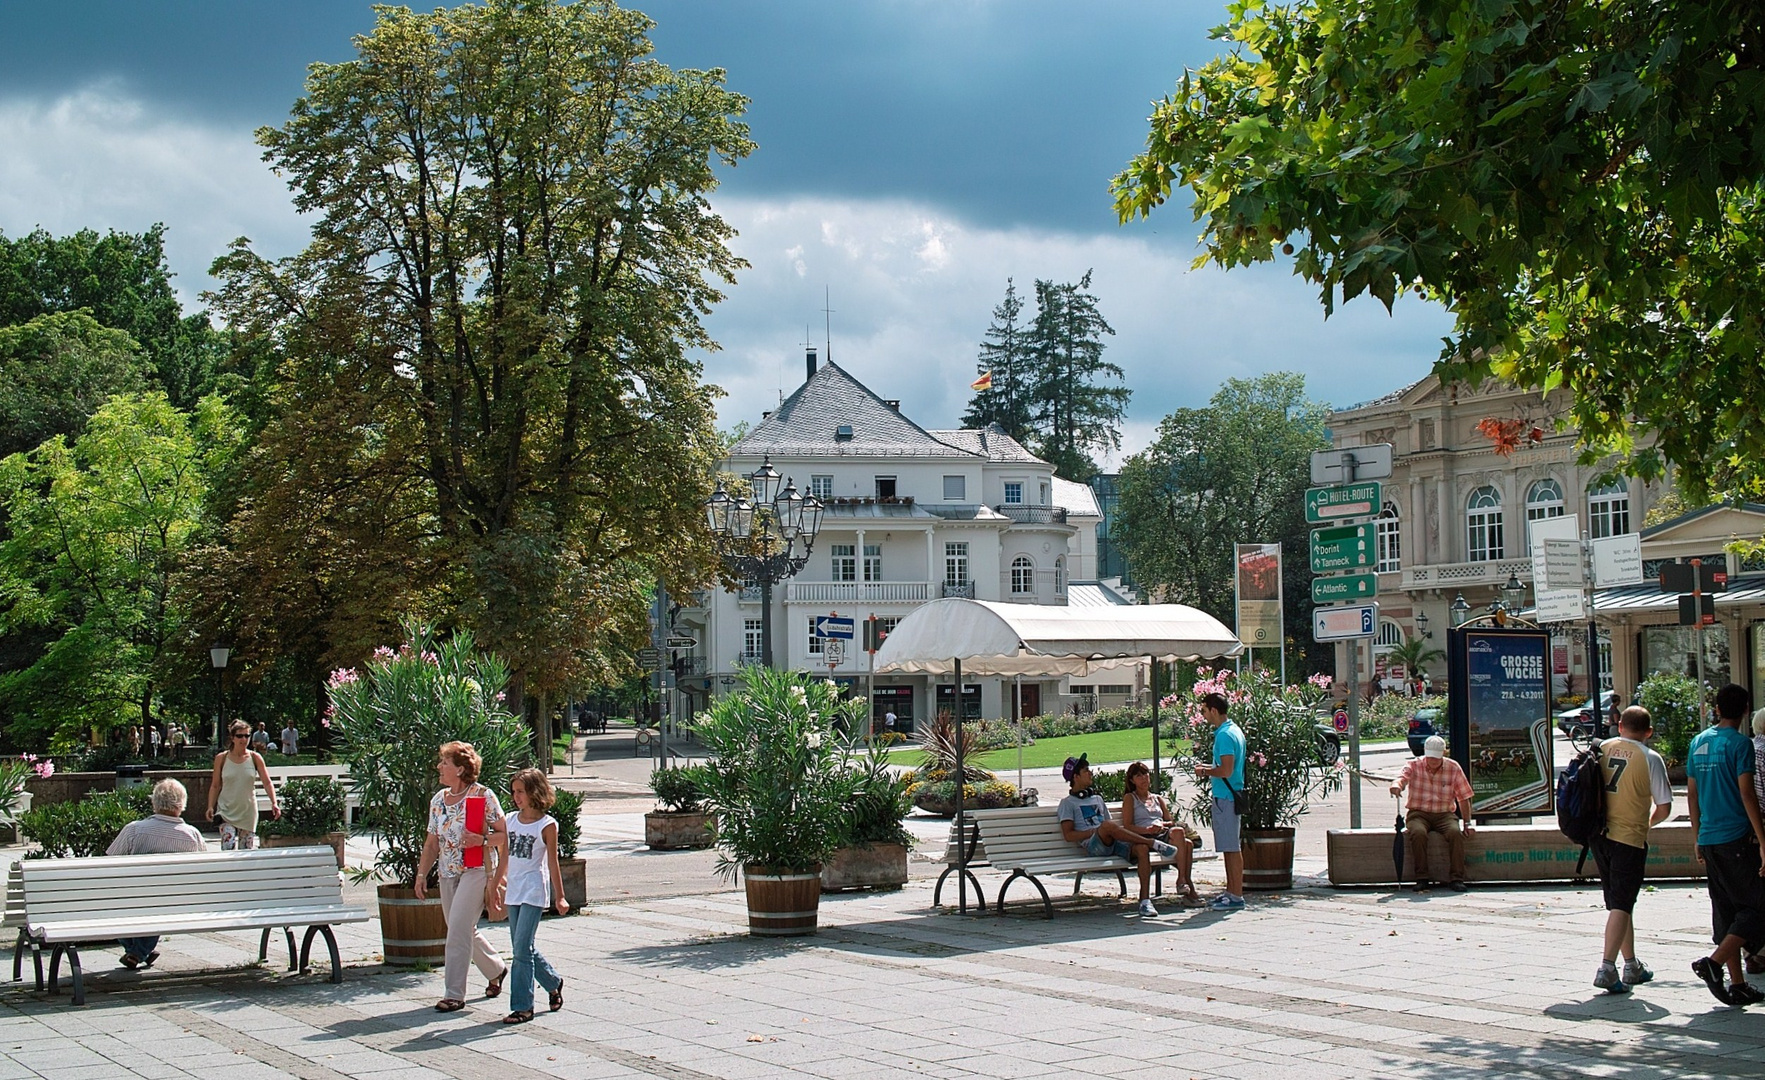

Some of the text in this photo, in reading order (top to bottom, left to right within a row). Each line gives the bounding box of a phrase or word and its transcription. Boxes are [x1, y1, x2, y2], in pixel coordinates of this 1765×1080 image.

[1514, 449, 1567, 465] THEATER
[1329, 487, 1374, 503] HOTEL-ROUTE
[1320, 544, 1340, 555] Dorint
[1321, 556, 1350, 568] Tanneck
[1322, 582, 1347, 594] Atlantic
[1363, 617, 1370, 630] P
[1500, 655, 1543, 668] GROSSE
[1505, 667, 1543, 679] WOCHE
[1501, 691, 1515, 699] 27.8.
[1520, 691, 1544, 699] 4.9.2011
[1607, 748, 1634, 759] JAM
[1605, 757, 1628, 793] 7
[1485, 850, 1525, 864] Menge
[1528, 848, 1554, 862] Holz
